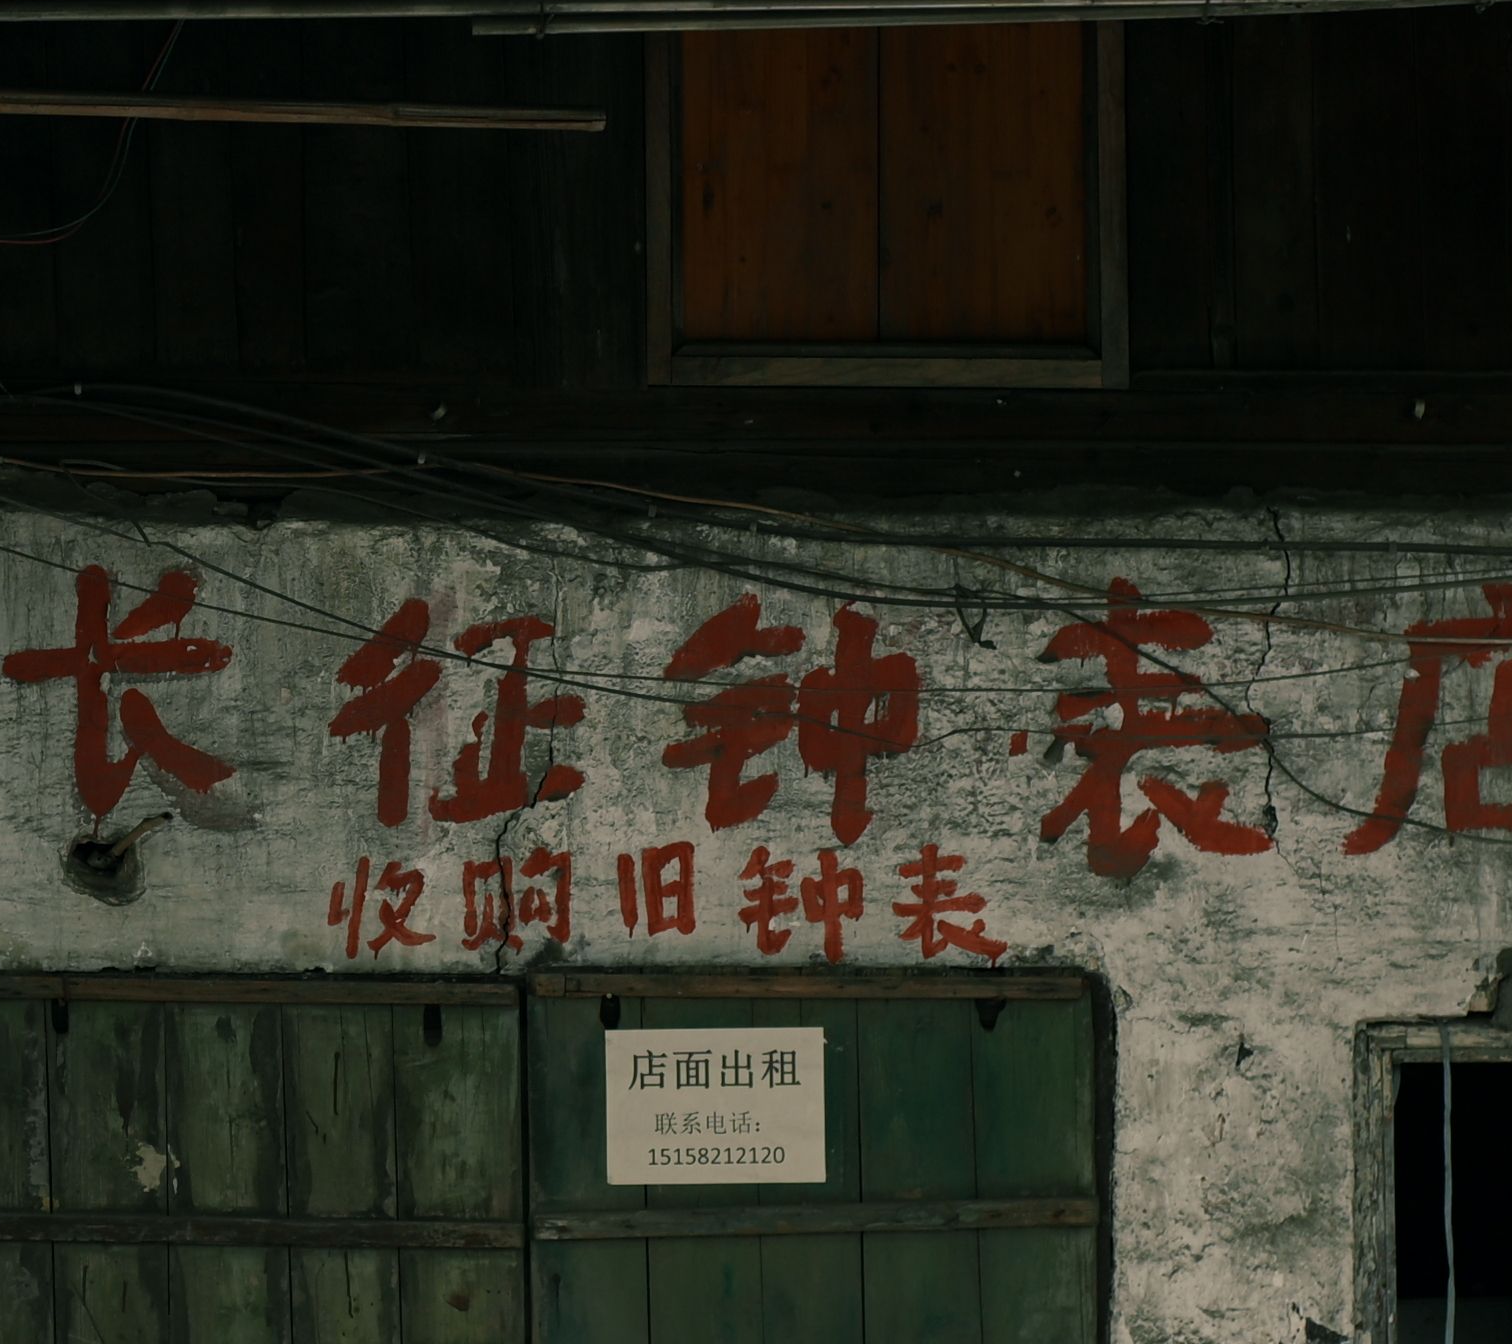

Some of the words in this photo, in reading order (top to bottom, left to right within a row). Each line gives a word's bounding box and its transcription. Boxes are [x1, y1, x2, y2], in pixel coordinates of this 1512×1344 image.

[326, 841, 1008, 970] 收购旧钟表
[628, 1049, 802, 1090] 店面出租
[654, 1110, 761, 1136] 联系电话：
[647, 1146, 786, 1166] 15158212120
